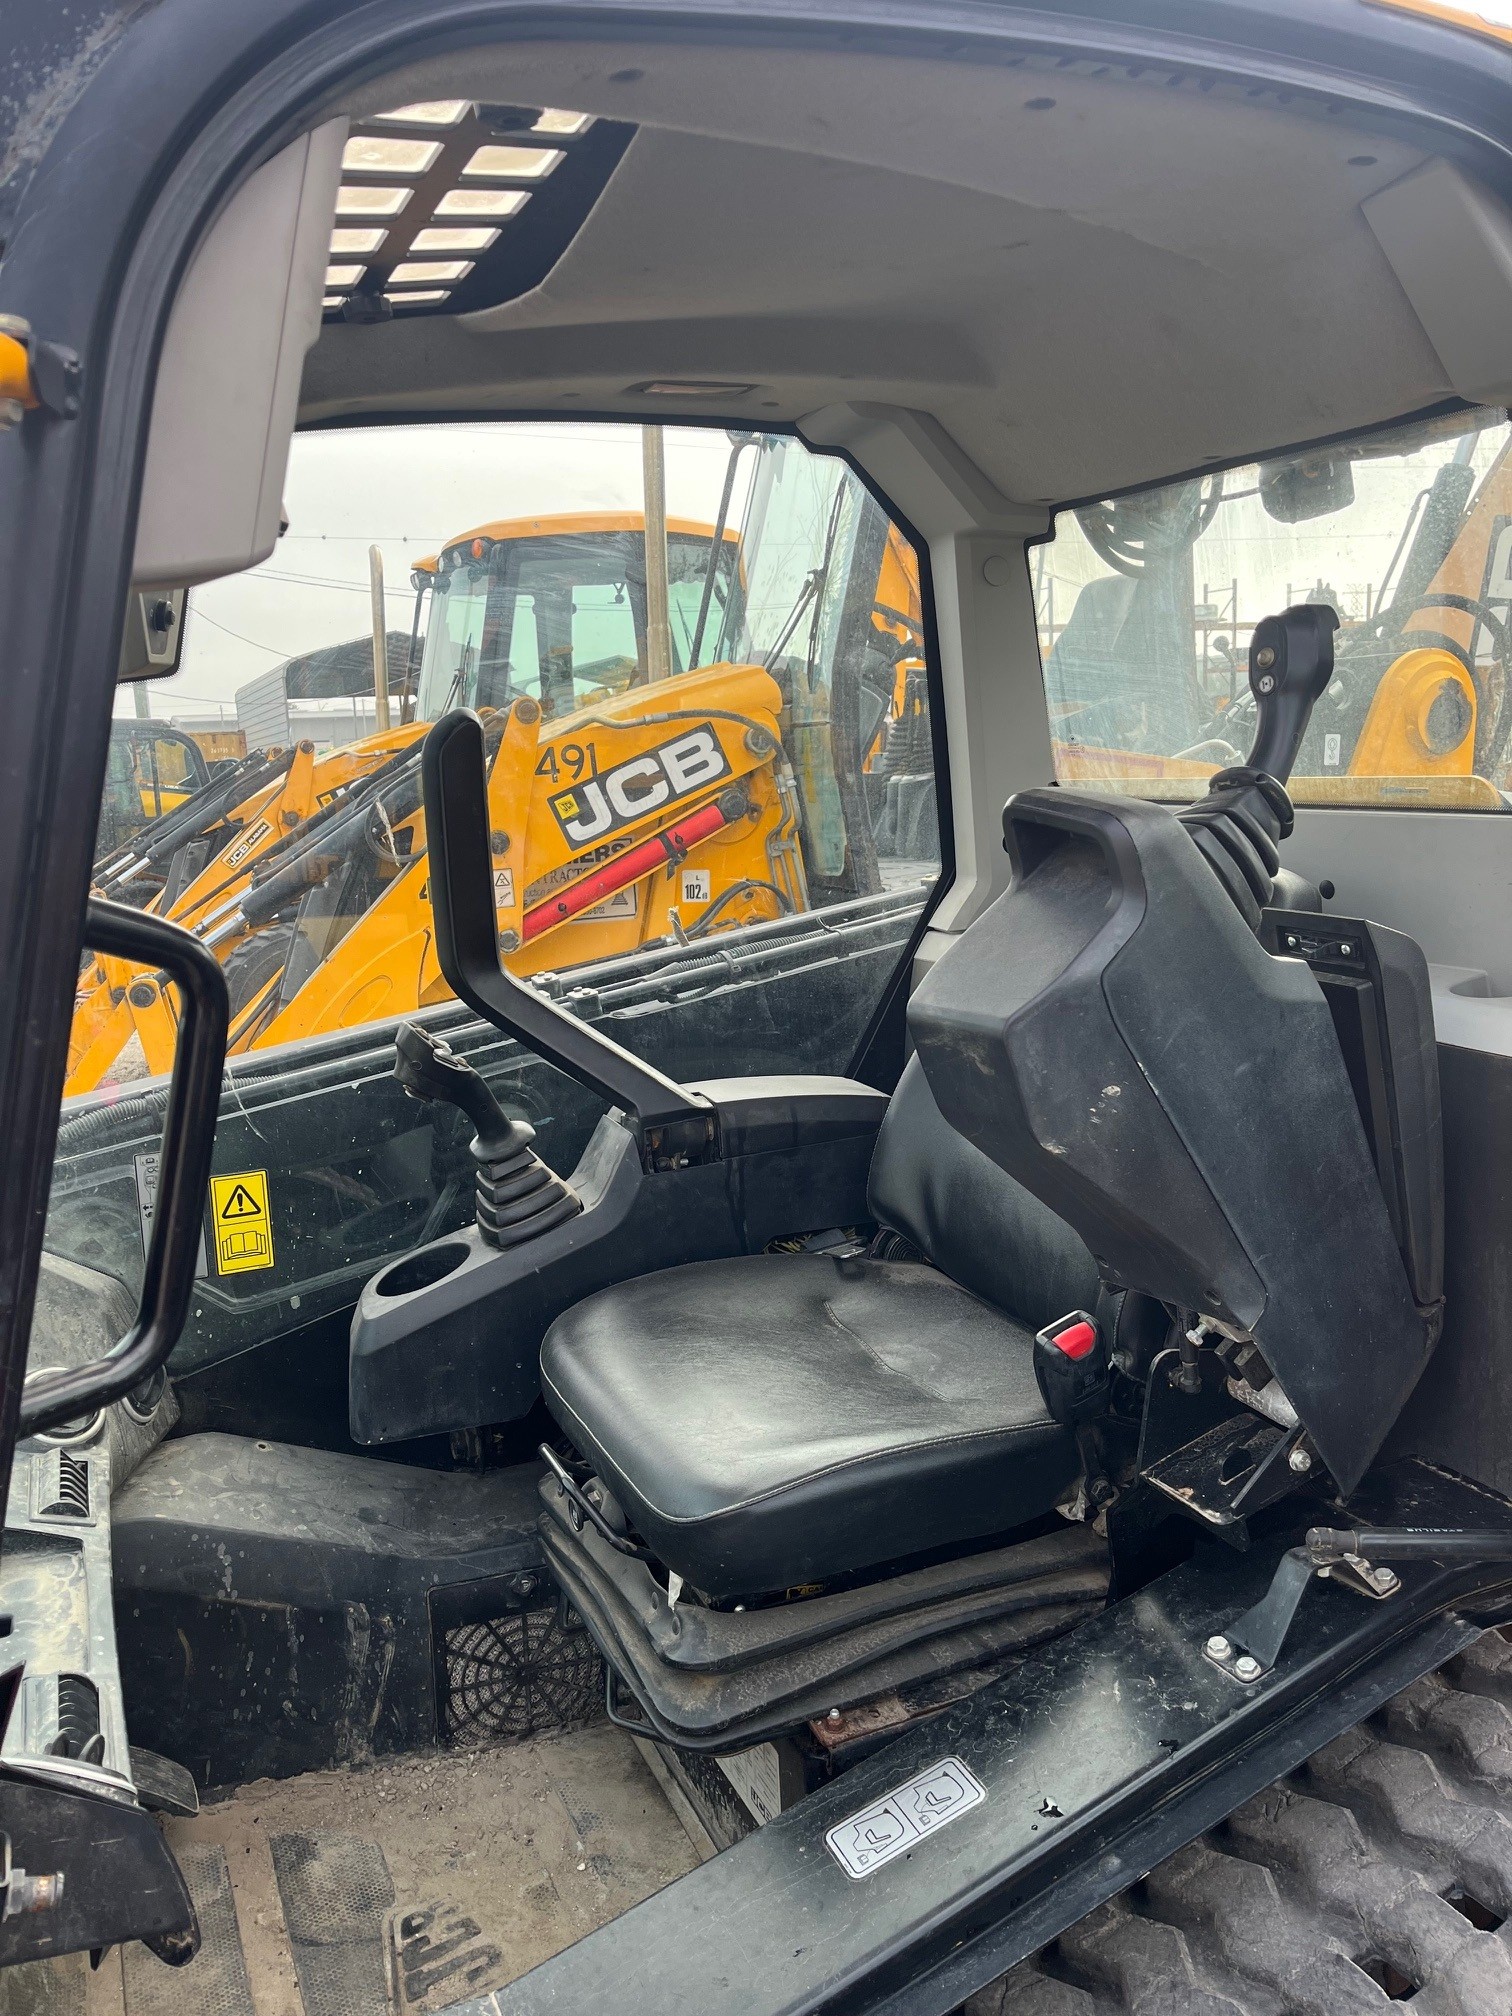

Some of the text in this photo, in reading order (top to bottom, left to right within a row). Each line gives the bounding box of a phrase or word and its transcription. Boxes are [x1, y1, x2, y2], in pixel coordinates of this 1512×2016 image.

[534, 742, 598, 783] 491
[565, 732, 724, 841] JCB
[229, 843, 249, 866] JCB
[685, 884, 701, 899] 102
